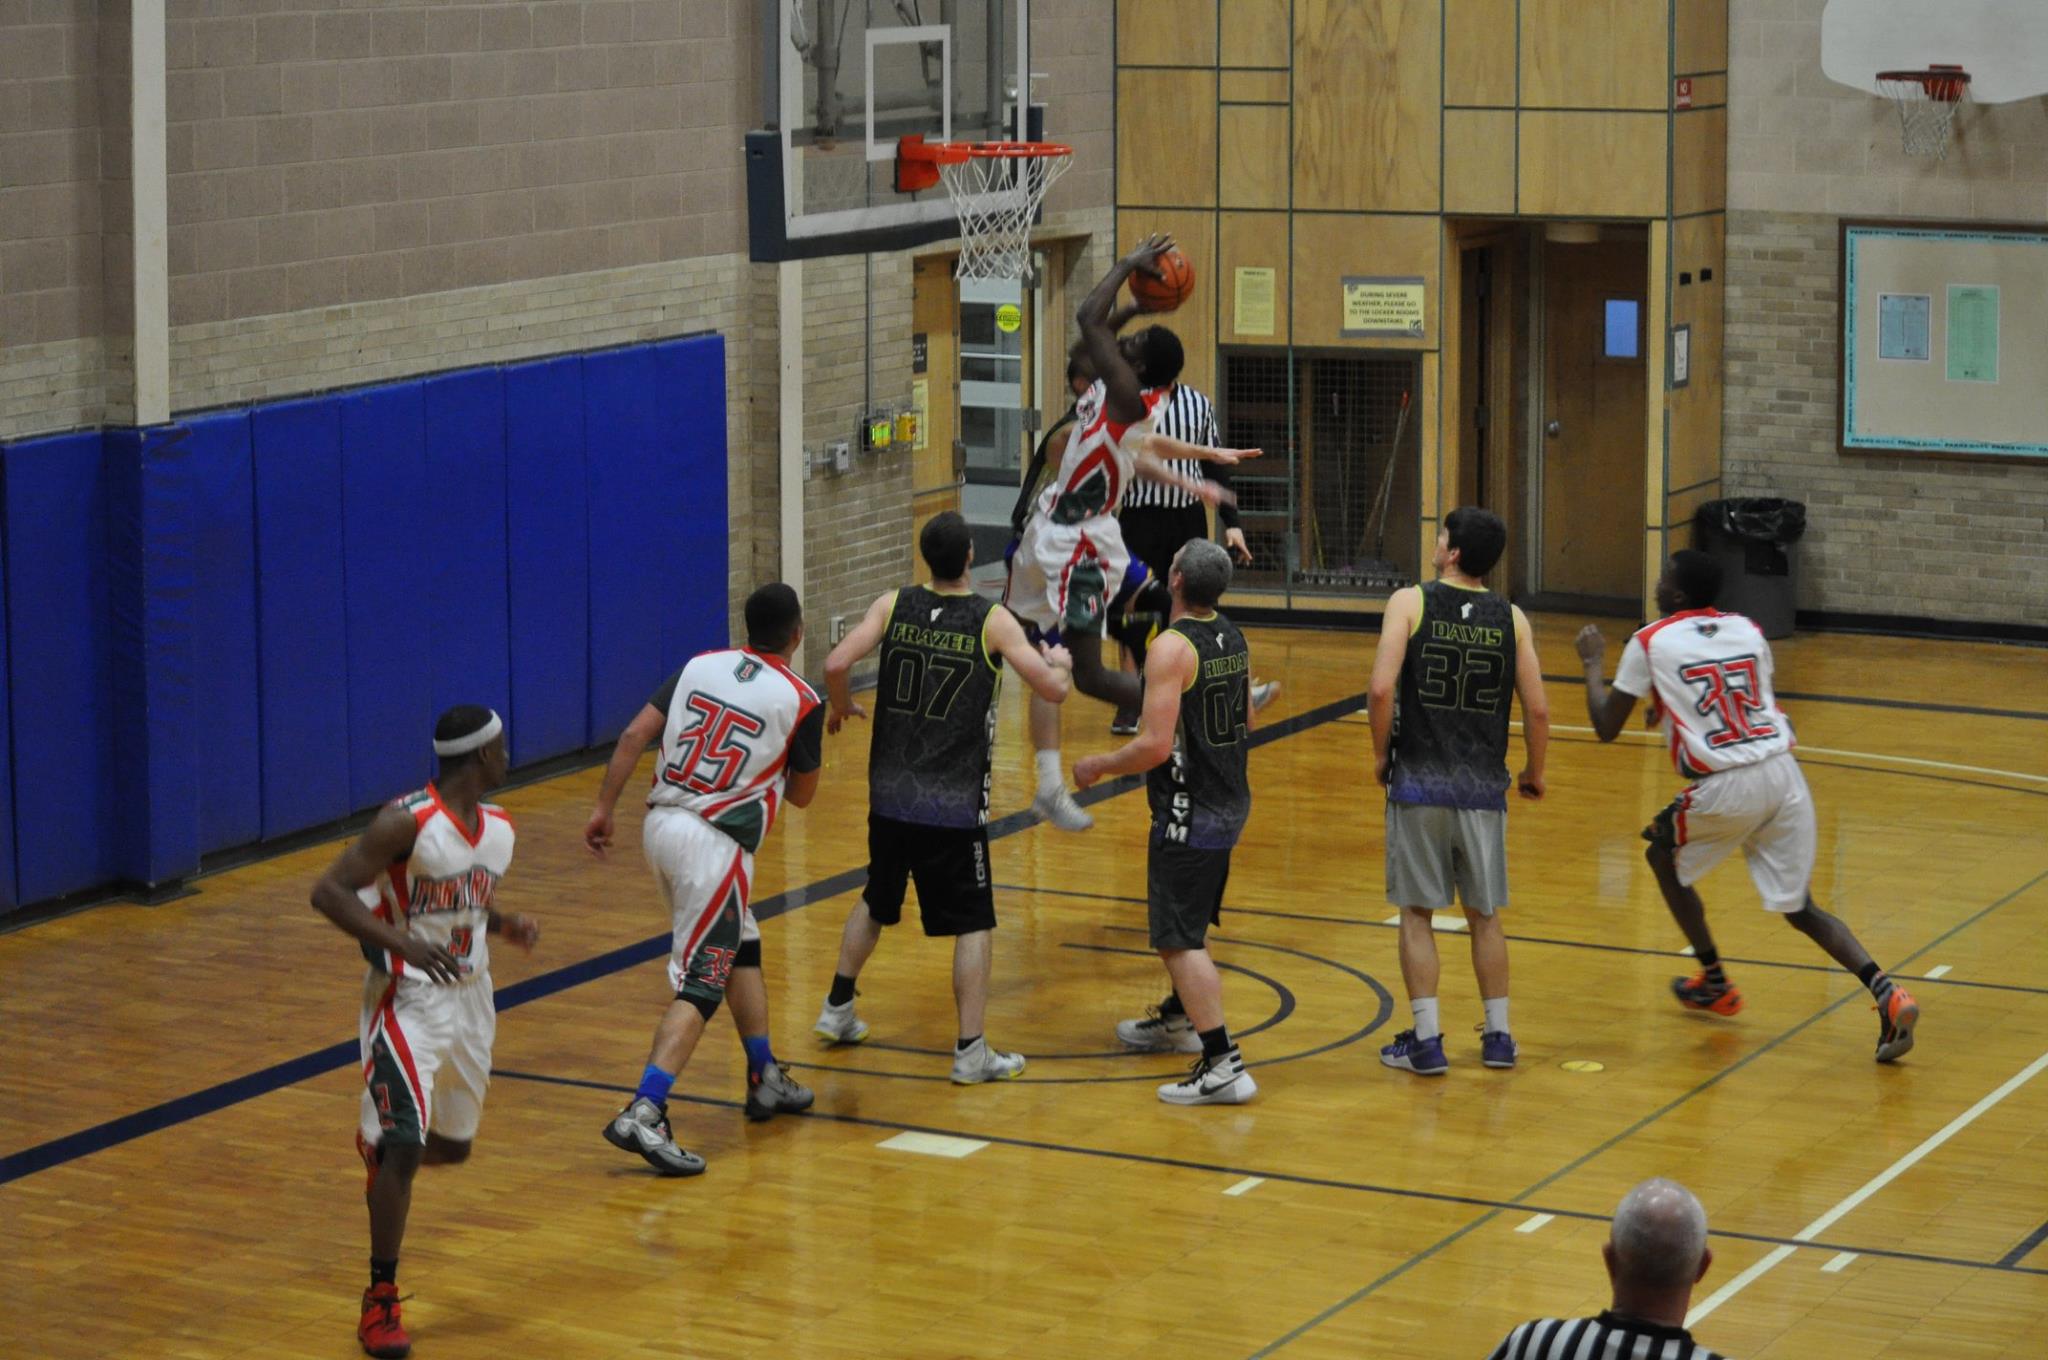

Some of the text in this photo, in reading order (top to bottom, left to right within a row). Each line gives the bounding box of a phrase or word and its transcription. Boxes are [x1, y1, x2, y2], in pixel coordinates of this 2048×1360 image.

[891, 622, 975, 653] FRAZEE
[1431, 620, 1503, 646] DAVIS
[885, 646, 974, 720] 07
[1418, 643, 1505, 713] 32
[662, 690, 766, 796] 35
[1165, 792, 1190, 843] GYM
